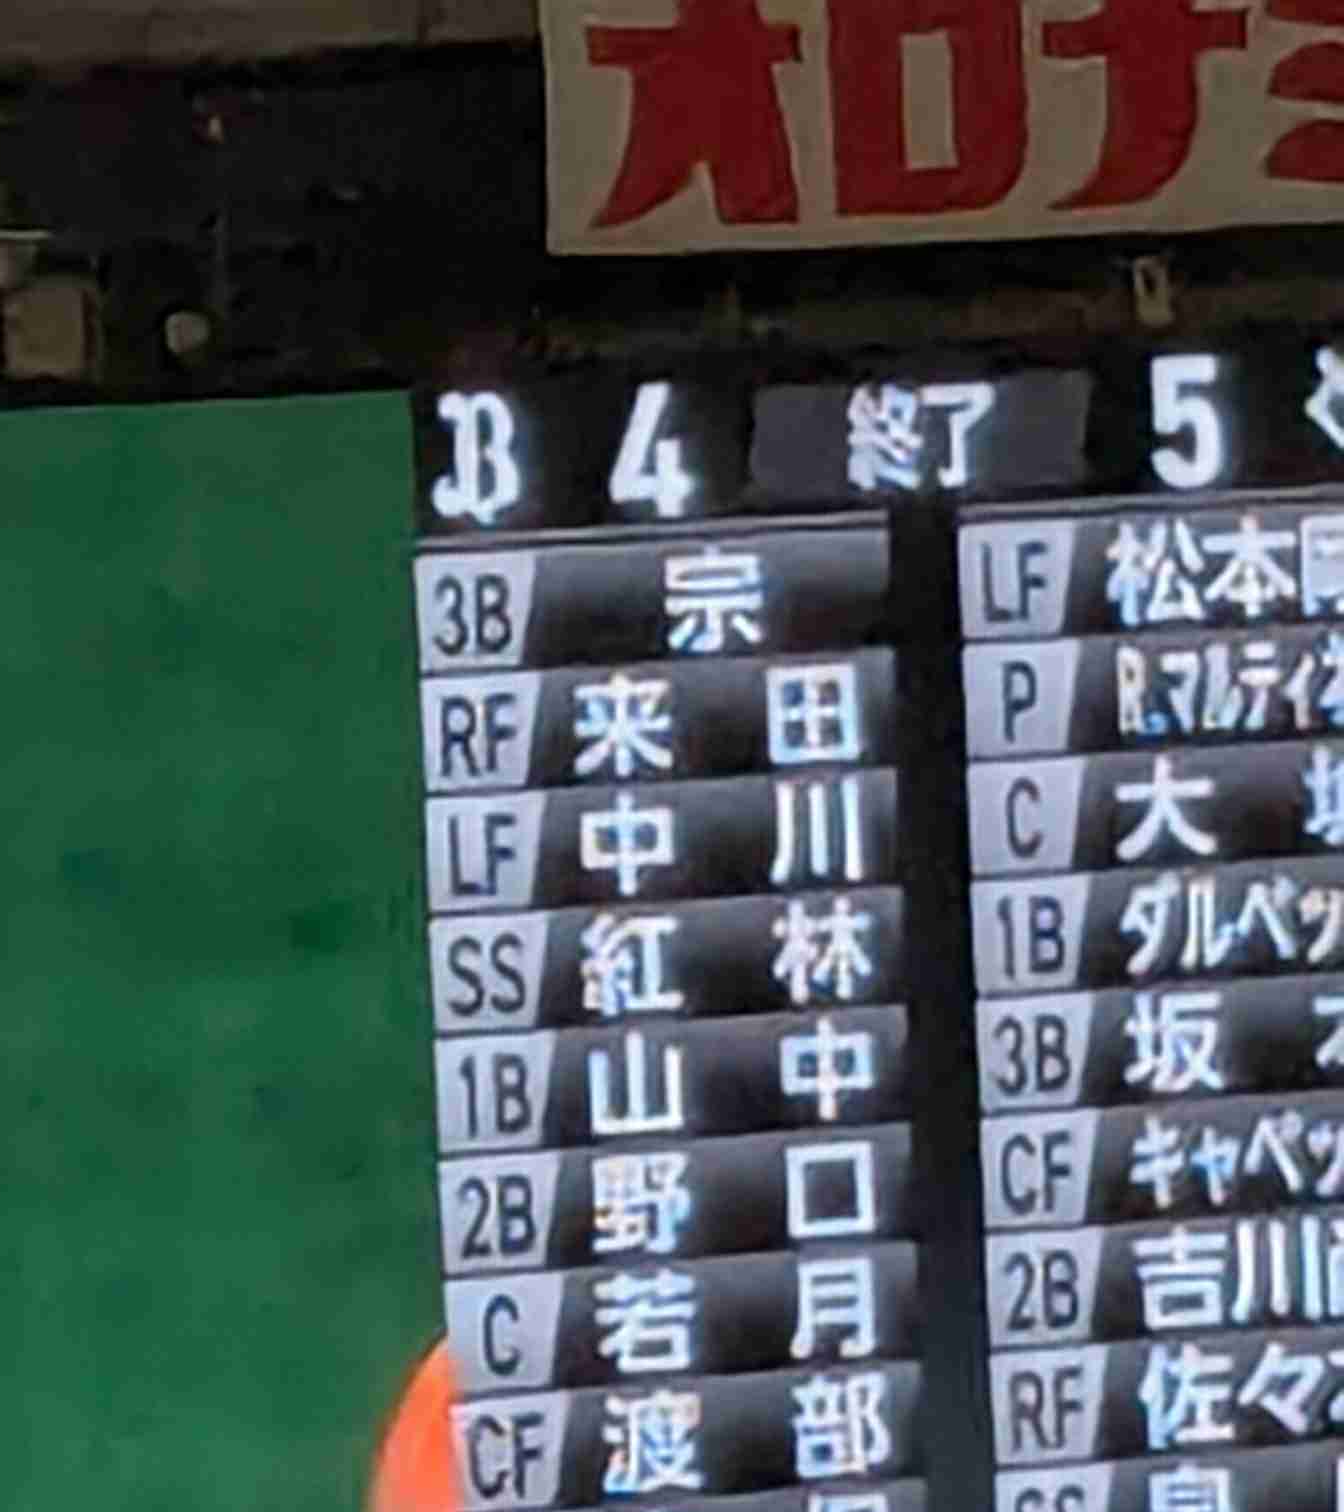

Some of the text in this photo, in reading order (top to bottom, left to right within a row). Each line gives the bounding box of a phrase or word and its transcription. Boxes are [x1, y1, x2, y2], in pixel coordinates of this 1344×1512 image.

[609, 381, 695, 517] 4
[847, 381, 995, 490] 終了
[1150, 354, 1223, 488] 5
[432, 574, 512, 655] 3B
[663, 543, 765, 653] 宗
[980, 542, 1047, 622] LF
[440, 694, 518, 778] RF
[1002, 661, 1037, 742] P
[448, 816, 518, 893] LF
[1004, 777, 1043, 859] C
[450, 935, 526, 1015] SS
[997, 895, 1064, 980] 1B
[458, 1055, 532, 1138] 1B
[994, 1014, 1072, 1096] 3B
[1000, 1130, 1072, 1215] CF
[462, 1175, 537, 1257] 2B
[1002, 1250, 1079, 1332] 2B
[1132, 1215, 1344, 1330] 吉川
[484, 1295, 522, 1376] C
[1009, 1365, 1083, 1452] RF
[1139, 1340, 1344, 1450] 佐々
[468, 1412, 545, 1499] CF
